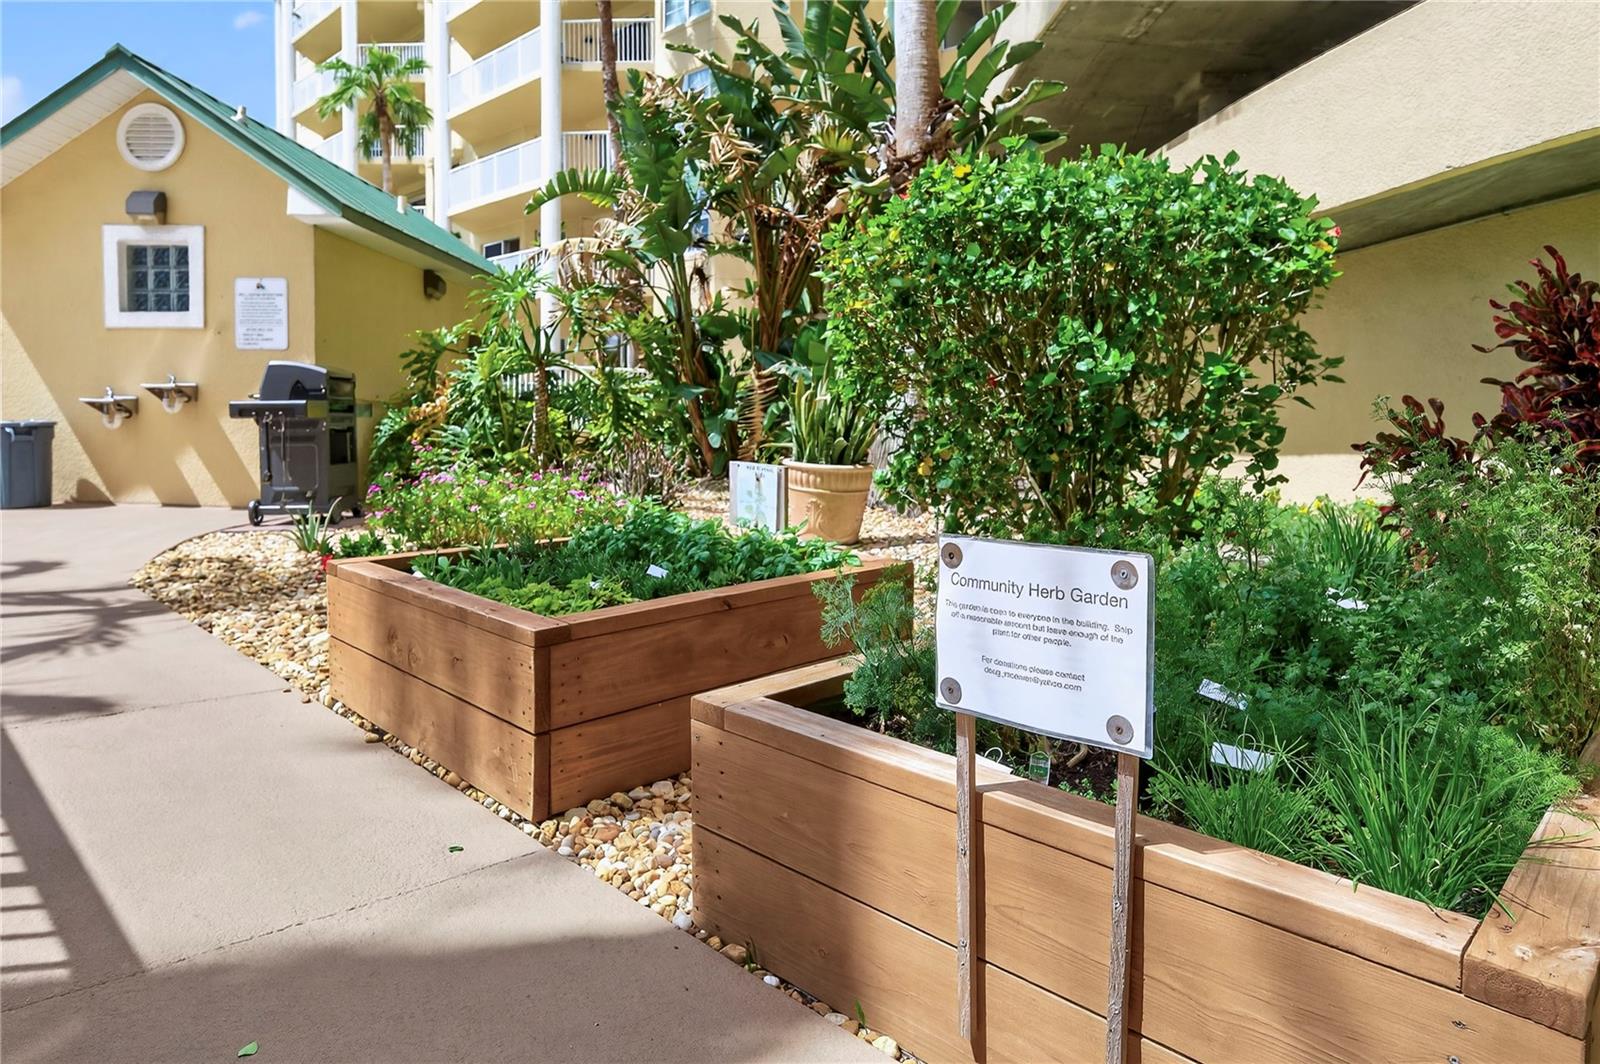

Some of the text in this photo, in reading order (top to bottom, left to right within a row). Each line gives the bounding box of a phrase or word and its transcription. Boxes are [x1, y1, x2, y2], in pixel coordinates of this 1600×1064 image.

[951, 571, 1129, 609] Community Herb Garden
[1009, 609, 1016, 618] to
[1017, 611, 1051, 624] everyone
[1052, 615, 1060, 624] in
[1061, 617, 1075, 626] the
[1011, 629, 1021, 638] for
[1032, 623, 1046, 633] but
[1046, 625, 1068, 636] leave
[1068, 629, 1099, 641] enough
[1100, 633, 1109, 641] of
[981, 655, 993, 664] For
[1028, 665, 1054, 677] please
[1054, 670, 1086, 682] contact
